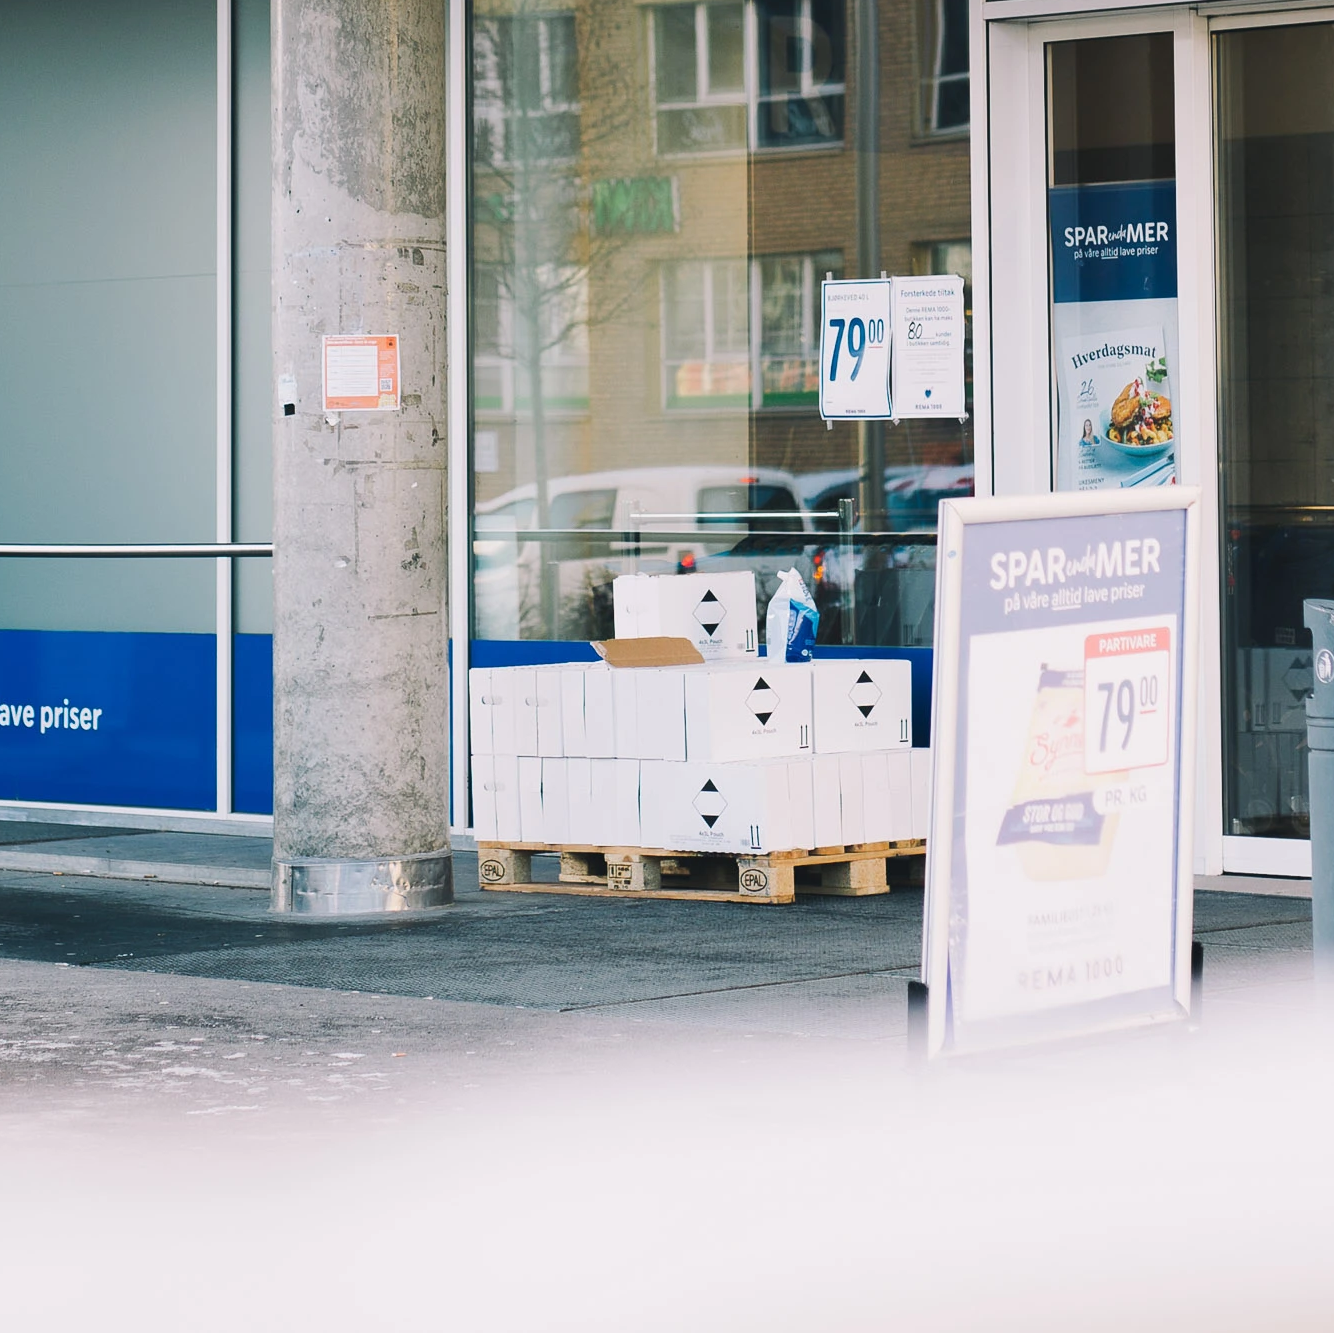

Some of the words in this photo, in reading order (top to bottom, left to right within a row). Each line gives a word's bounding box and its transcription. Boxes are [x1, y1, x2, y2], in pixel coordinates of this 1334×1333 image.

[1064, 225, 1108, 247] SPAR
[1126, 222, 1168, 243] MER
[1074, 249, 1083, 260] på
[1084, 248, 1099, 257] våre
[1101, 247, 1118, 257] alltid
[1120, 246, 1135, 256] lave
[1137, 246, 1158, 257] priser
[901, 289, 936, 297] Forsterkede
[938, 288, 955, 296] tiltak
[908, 322, 923, 339] 80
[829, 317, 865, 382] 79
[868, 319, 884, 343] 00
[1071, 342, 1157, 369] Hverdagsmat
[989, 547, 1066, 590] SPAR
[1096, 538, 1160, 578] MER
[1004, 592, 1020, 615] på
[1023, 590, 1049, 610] våre
[1052, 587, 1081, 606] alltid
[1085, 586, 1108, 603] lave
[1111, 582, 1145, 604] priser
[1099, 634, 1157, 653] PARTIVARE
[39, 698, 103, 735] priser
[1097, 677, 1136, 754] 79
[1139, 675, 1158, 708] 00
[1104, 789, 1126, 808] PR.
[1130, 785, 1147, 804] KG
[483, 864, 504, 878] EPAL
[743, 874, 764, 887] EPAL
